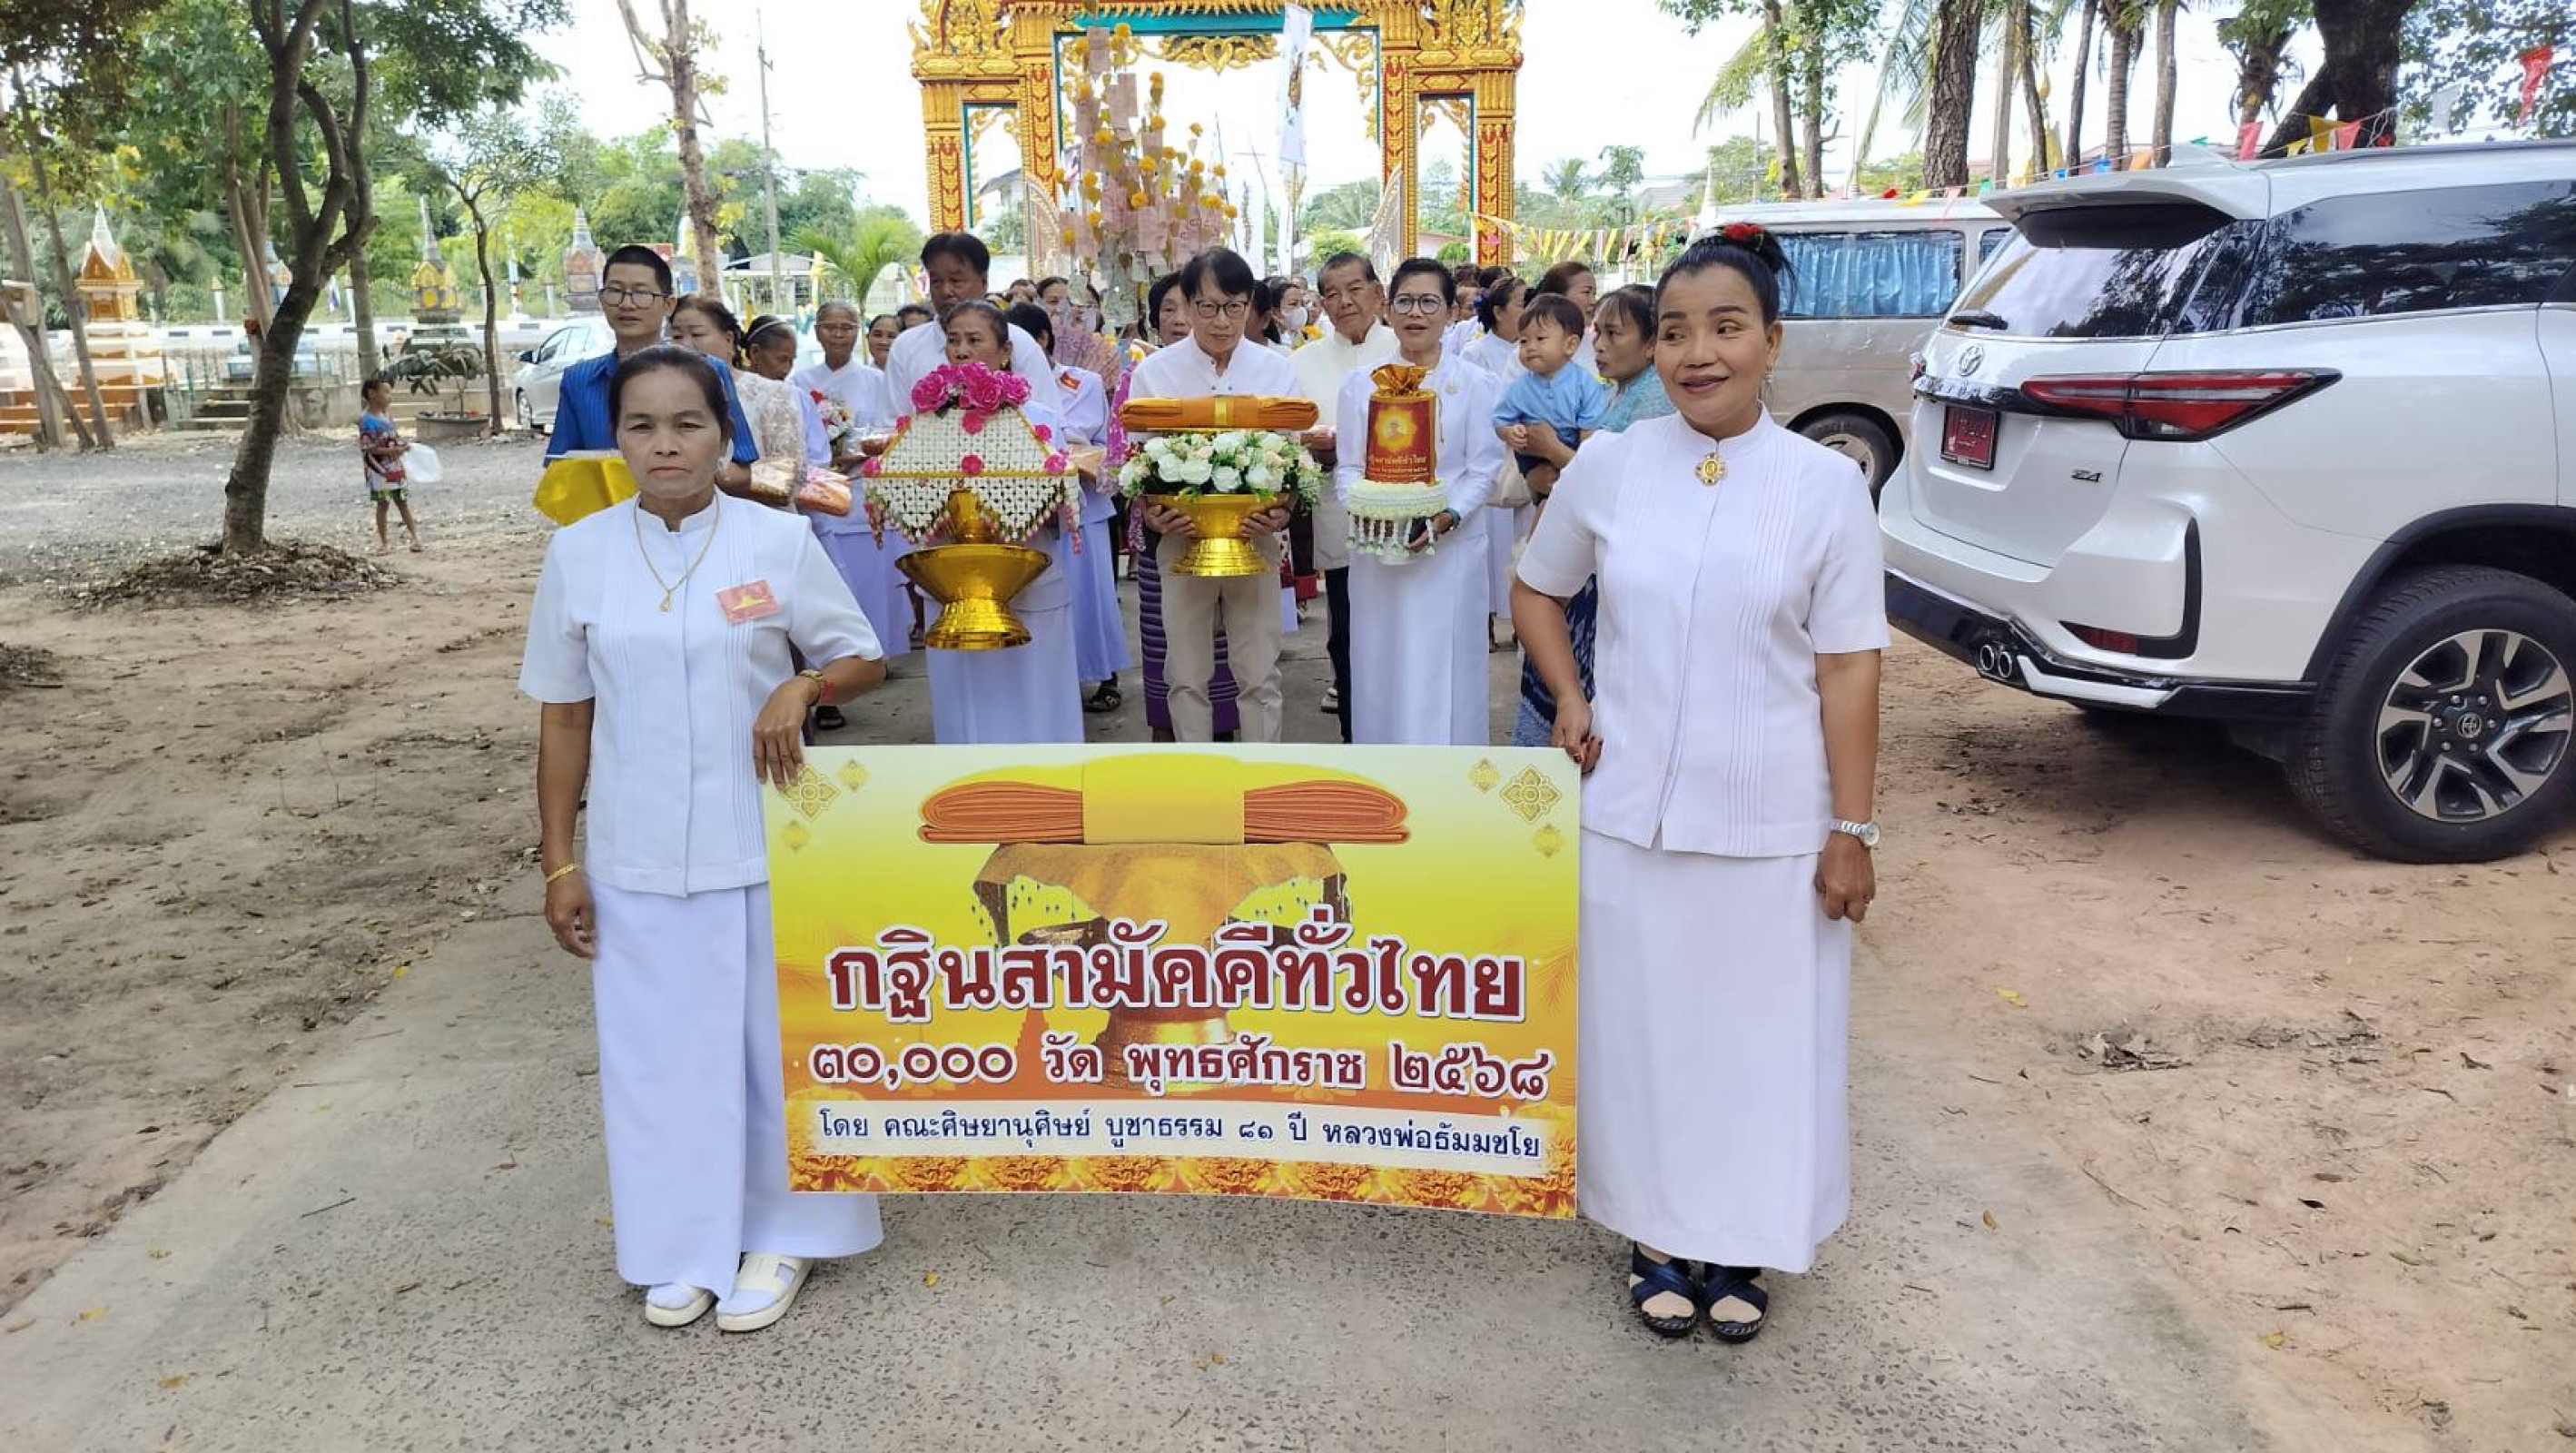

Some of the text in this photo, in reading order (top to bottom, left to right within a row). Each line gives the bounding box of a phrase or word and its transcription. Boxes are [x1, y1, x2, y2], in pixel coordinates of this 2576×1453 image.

[828, 906, 1524, 1019] กฐินสามัคคีทั่วไทย
[812, 1033, 1550, 1096] ๓๐,๐๐๐ วัด พุทธศักราช ๒๕๖๘
[819, 1108, 1540, 1158] โดย คณะศิษยานุศิษย์ บูชาธรรม ๘๑ ปี หลวงพ่อธัมมชโย
